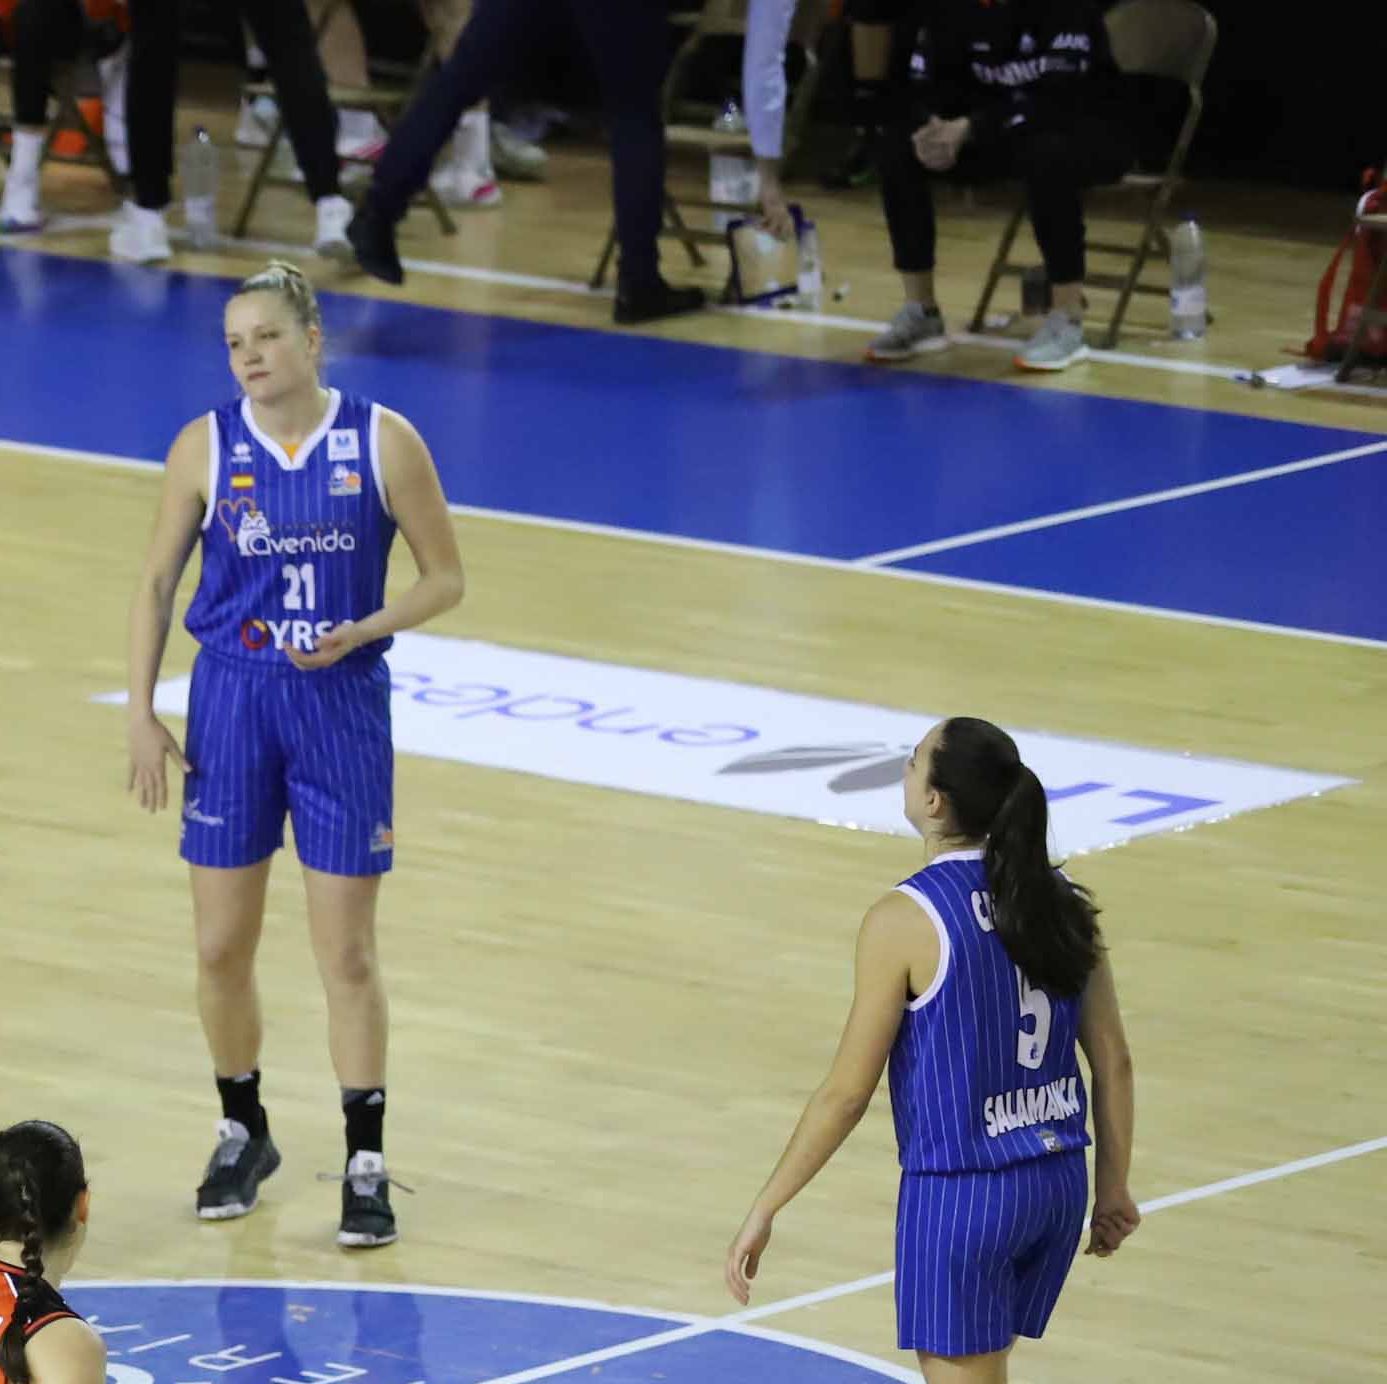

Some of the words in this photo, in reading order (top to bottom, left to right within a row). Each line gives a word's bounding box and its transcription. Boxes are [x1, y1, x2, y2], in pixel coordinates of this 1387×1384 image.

[248, 529, 355, 556] avenida
[282, 563, 315, 610] 21
[391, 671, 759, 748] endes
[1015, 965, 1052, 1069] 5
